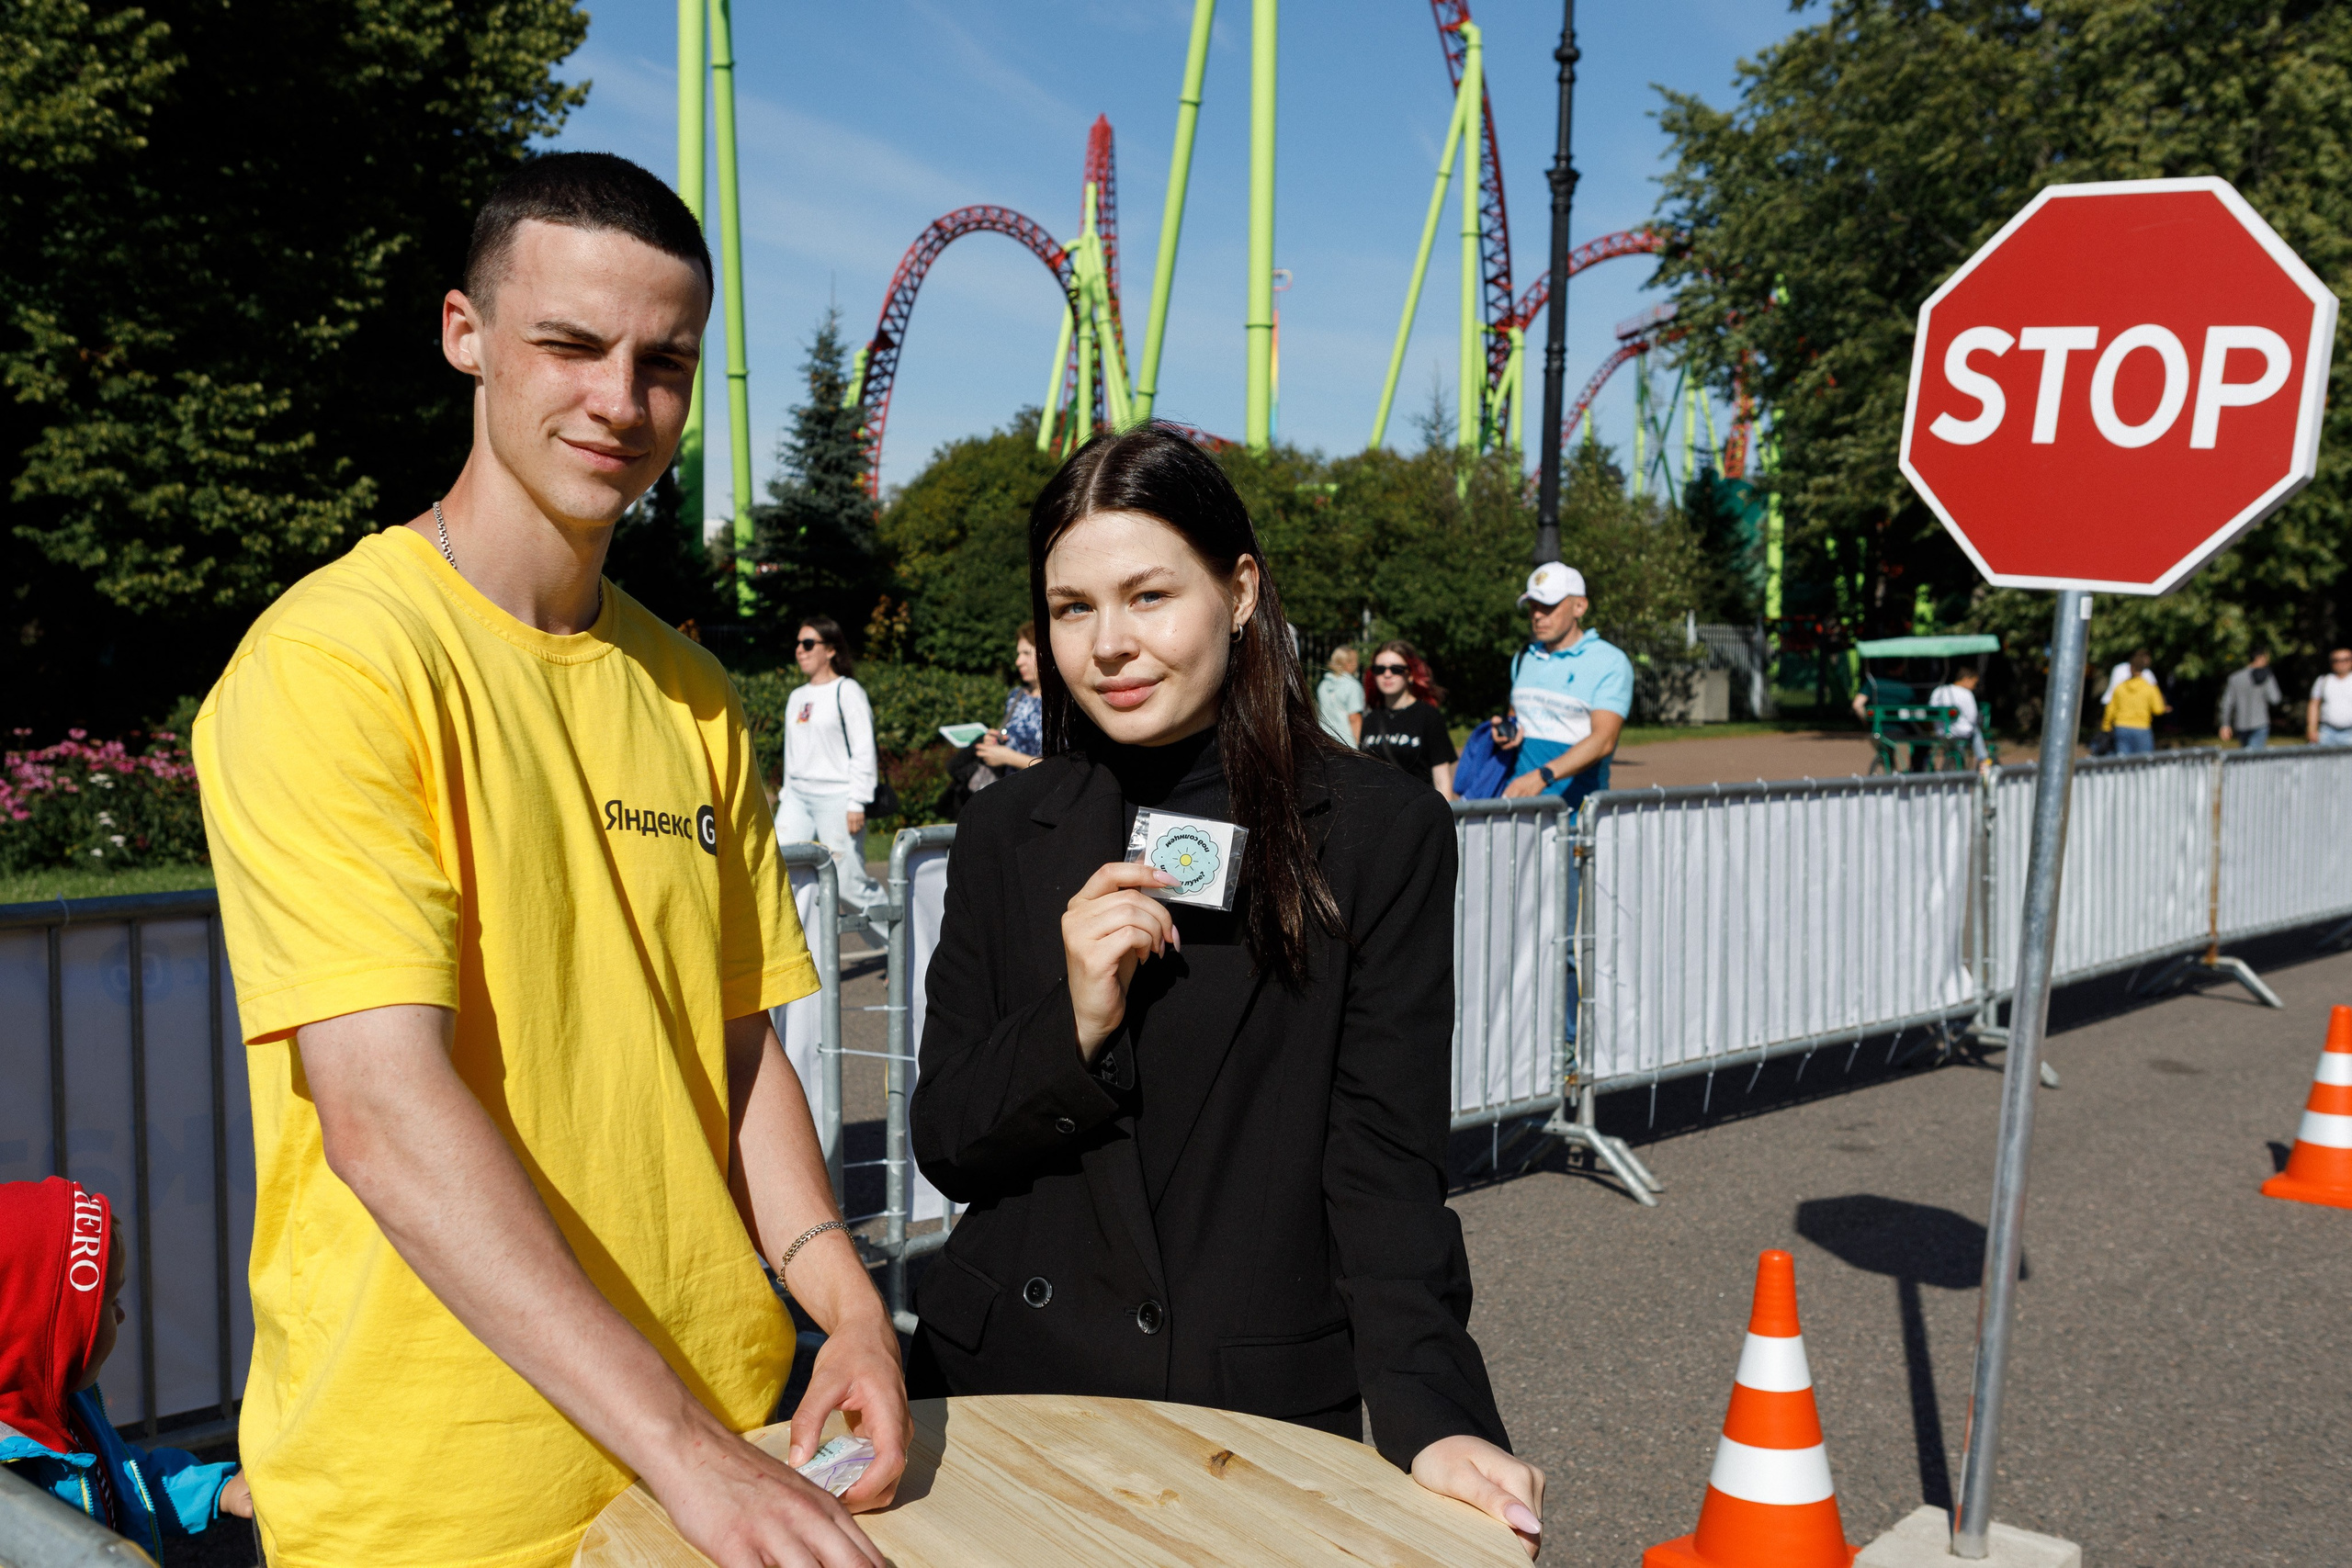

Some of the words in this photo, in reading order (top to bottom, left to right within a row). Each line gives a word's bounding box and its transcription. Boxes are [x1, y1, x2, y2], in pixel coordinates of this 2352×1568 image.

[1929, 323, 2292, 449] STOP
[605, 800, 693, 840] Яндекс
[1165, 833, 1199, 848] солнцем
[1198, 839, 1210, 853] под
